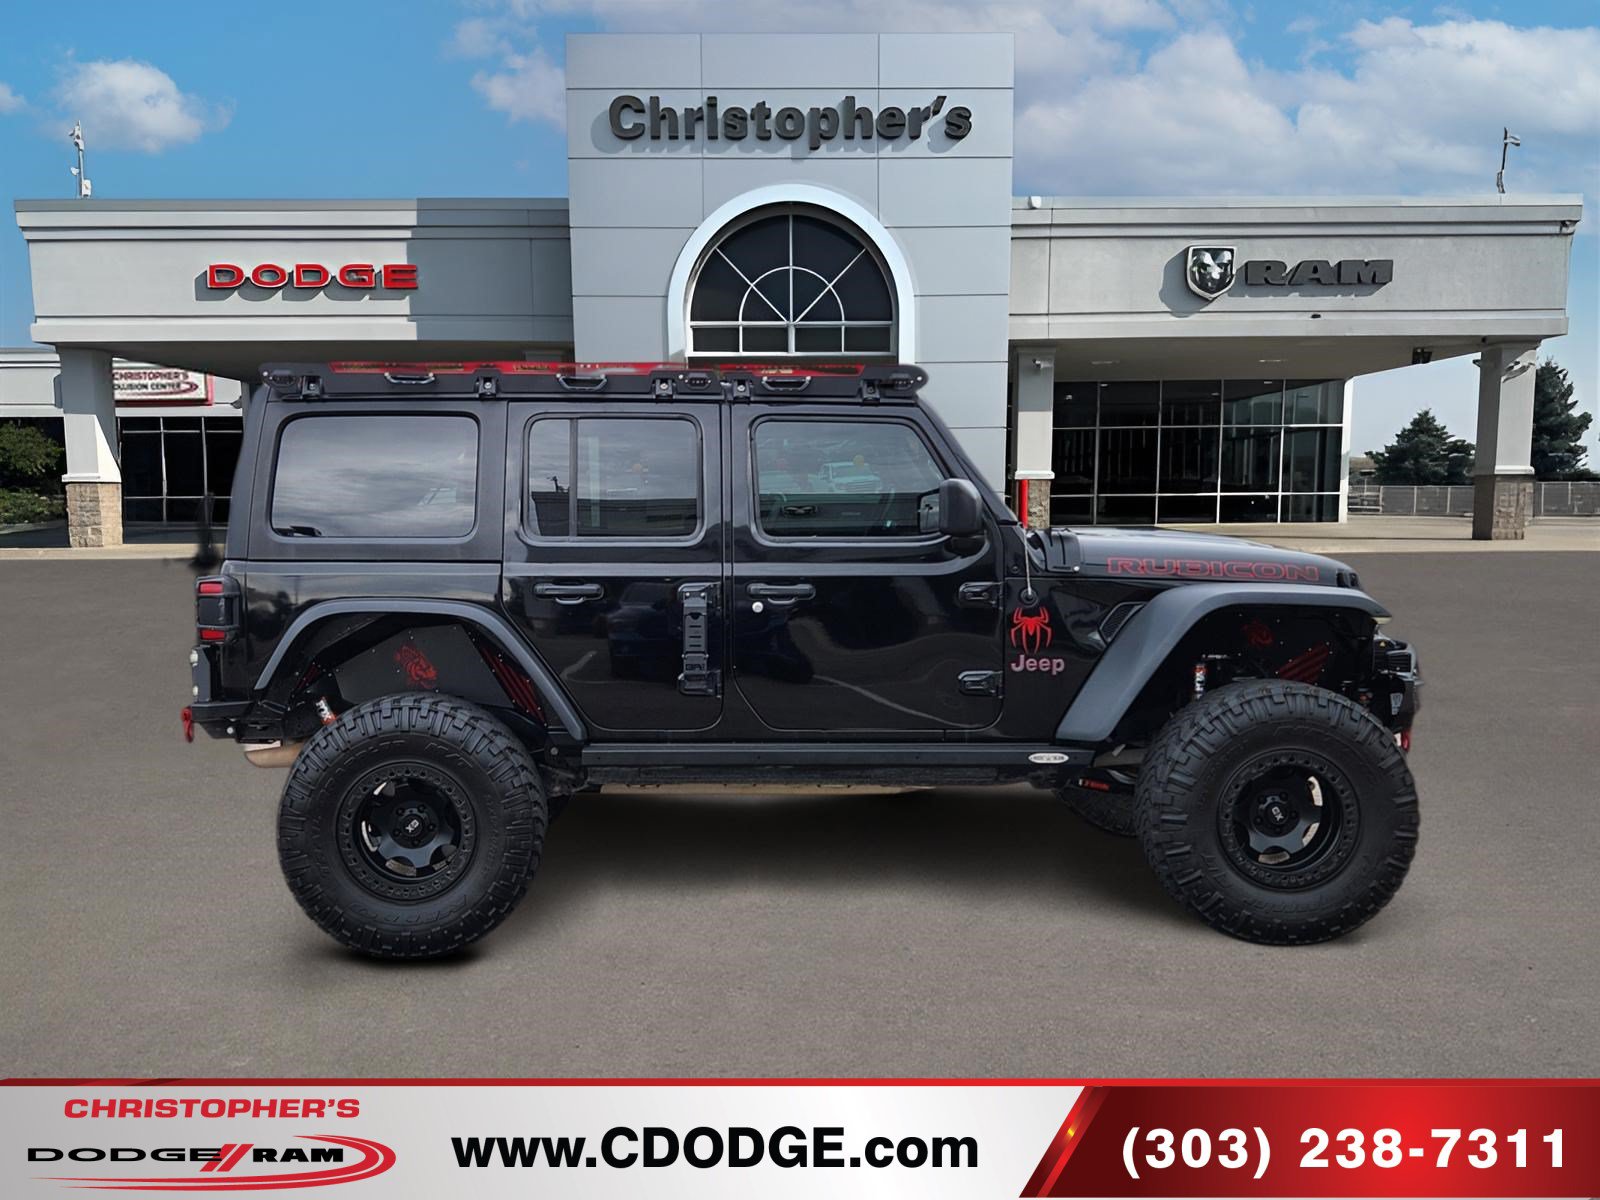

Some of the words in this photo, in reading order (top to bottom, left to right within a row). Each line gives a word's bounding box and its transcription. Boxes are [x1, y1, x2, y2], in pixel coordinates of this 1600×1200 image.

[608, 95, 972, 151] Christopher's
[207, 263, 418, 289] DODGE
[1244, 259, 1394, 286] RAM
[112, 383, 149, 391] OLLISION
[150, 382, 181, 391] CENTER
[1107, 557, 1320, 581] RUBICON
[1010, 654, 1065, 676] Jeep
